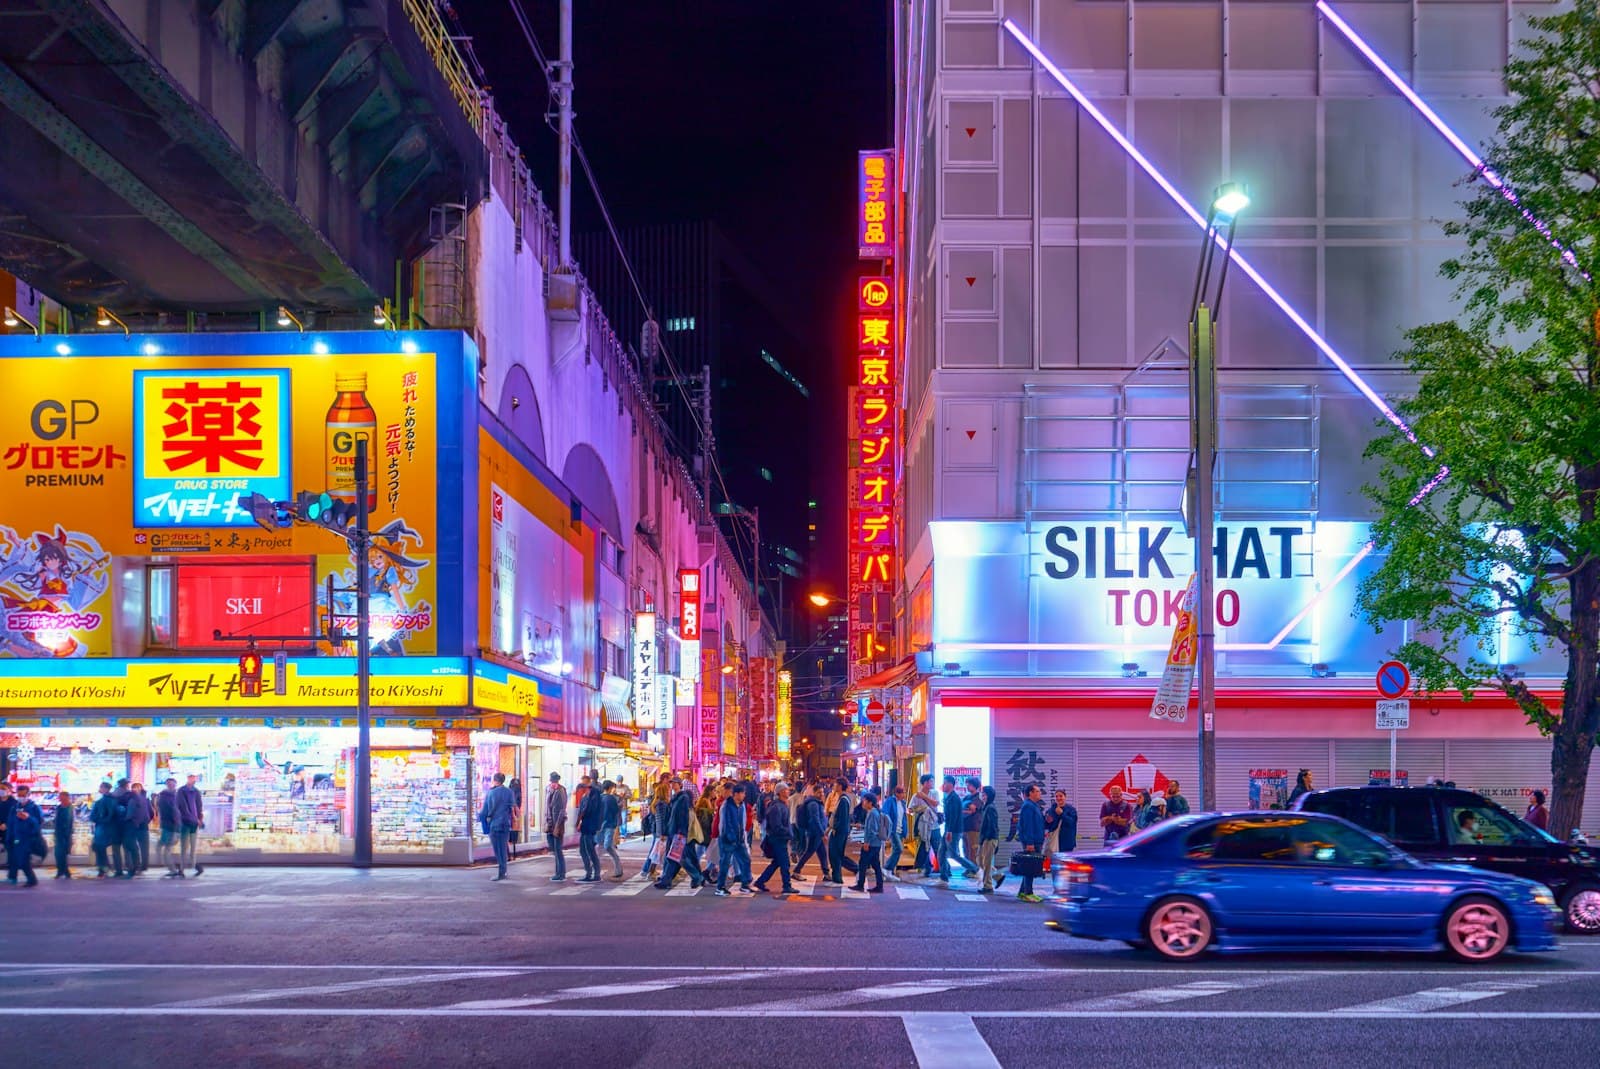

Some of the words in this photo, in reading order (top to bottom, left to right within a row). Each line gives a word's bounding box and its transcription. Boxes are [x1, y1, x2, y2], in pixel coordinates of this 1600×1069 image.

[864, 157, 886, 244] 電子部品
[31, 399, 100, 441] GP
[162, 381, 264, 473] 薬
[3, 443, 126, 470] グロモント
[25, 474, 104, 487] PREMIUM
[174, 480, 208, 490] DRUG
[210, 480, 249, 490] STORE
[143, 491, 277, 523] マツモトキ
[253, 536, 292, 547] Project
[1045, 525, 1175, 580] SILK
[1213, 527, 1303, 579] HAT
[226, 597, 262, 615] SK-II
[1107, 589, 1240, 627] TOKO
[8, 613, 100, 630] コラボキャンペーン
[335, 613, 430, 630] アクルスタンド
[683, 602, 697, 636] KFC
[71, 686, 127, 698] KiYoshi
[148, 673, 277, 701] マツモトキシ
[297, 685, 385, 698] Matsumto
[387, 685, 443, 698] KiYoshi
[1478, 788, 1499, 796] SILK
[1501, 788, 1518, 796] HAT
[1520, 788, 1549, 796] TOO
